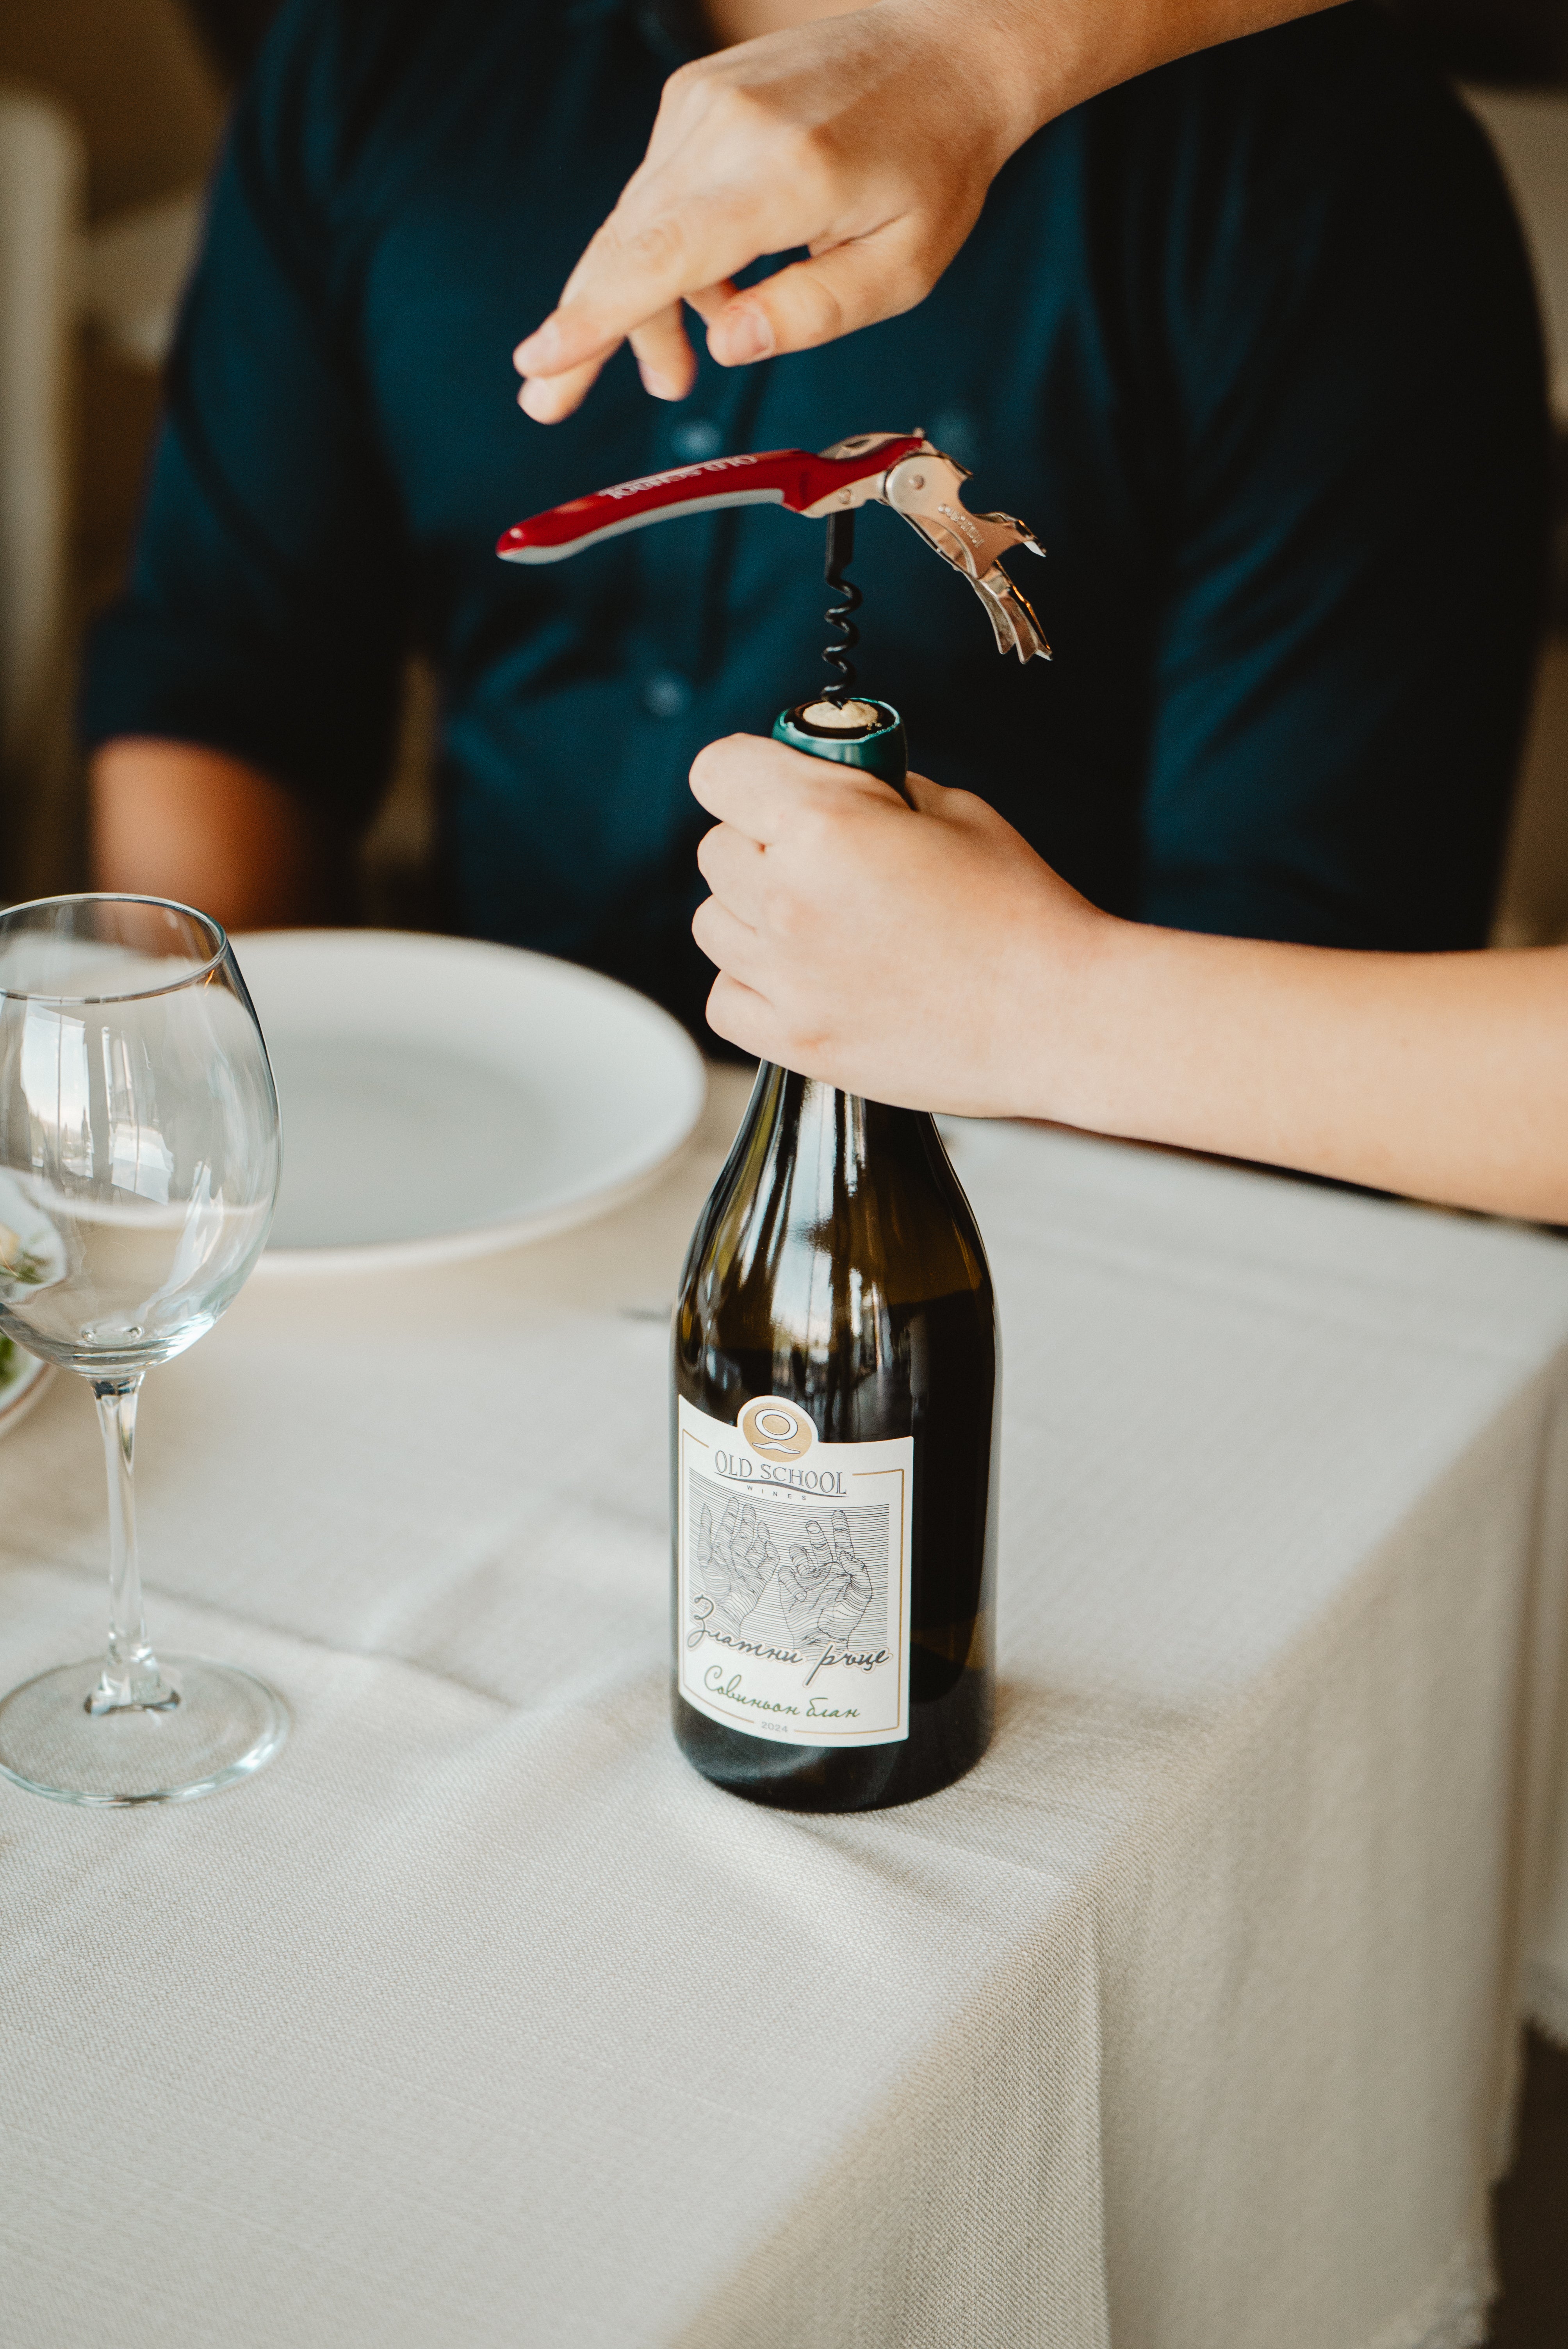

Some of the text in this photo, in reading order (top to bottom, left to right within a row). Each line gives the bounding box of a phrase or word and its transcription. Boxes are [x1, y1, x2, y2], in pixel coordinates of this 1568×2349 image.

[715, 1450, 846, 1494] OLD SCHOOL
[747, 1485, 806, 1501] WINES
[704, 1665, 860, 1718] Совиньон блан
[762, 1722, 788, 1732] 2024
